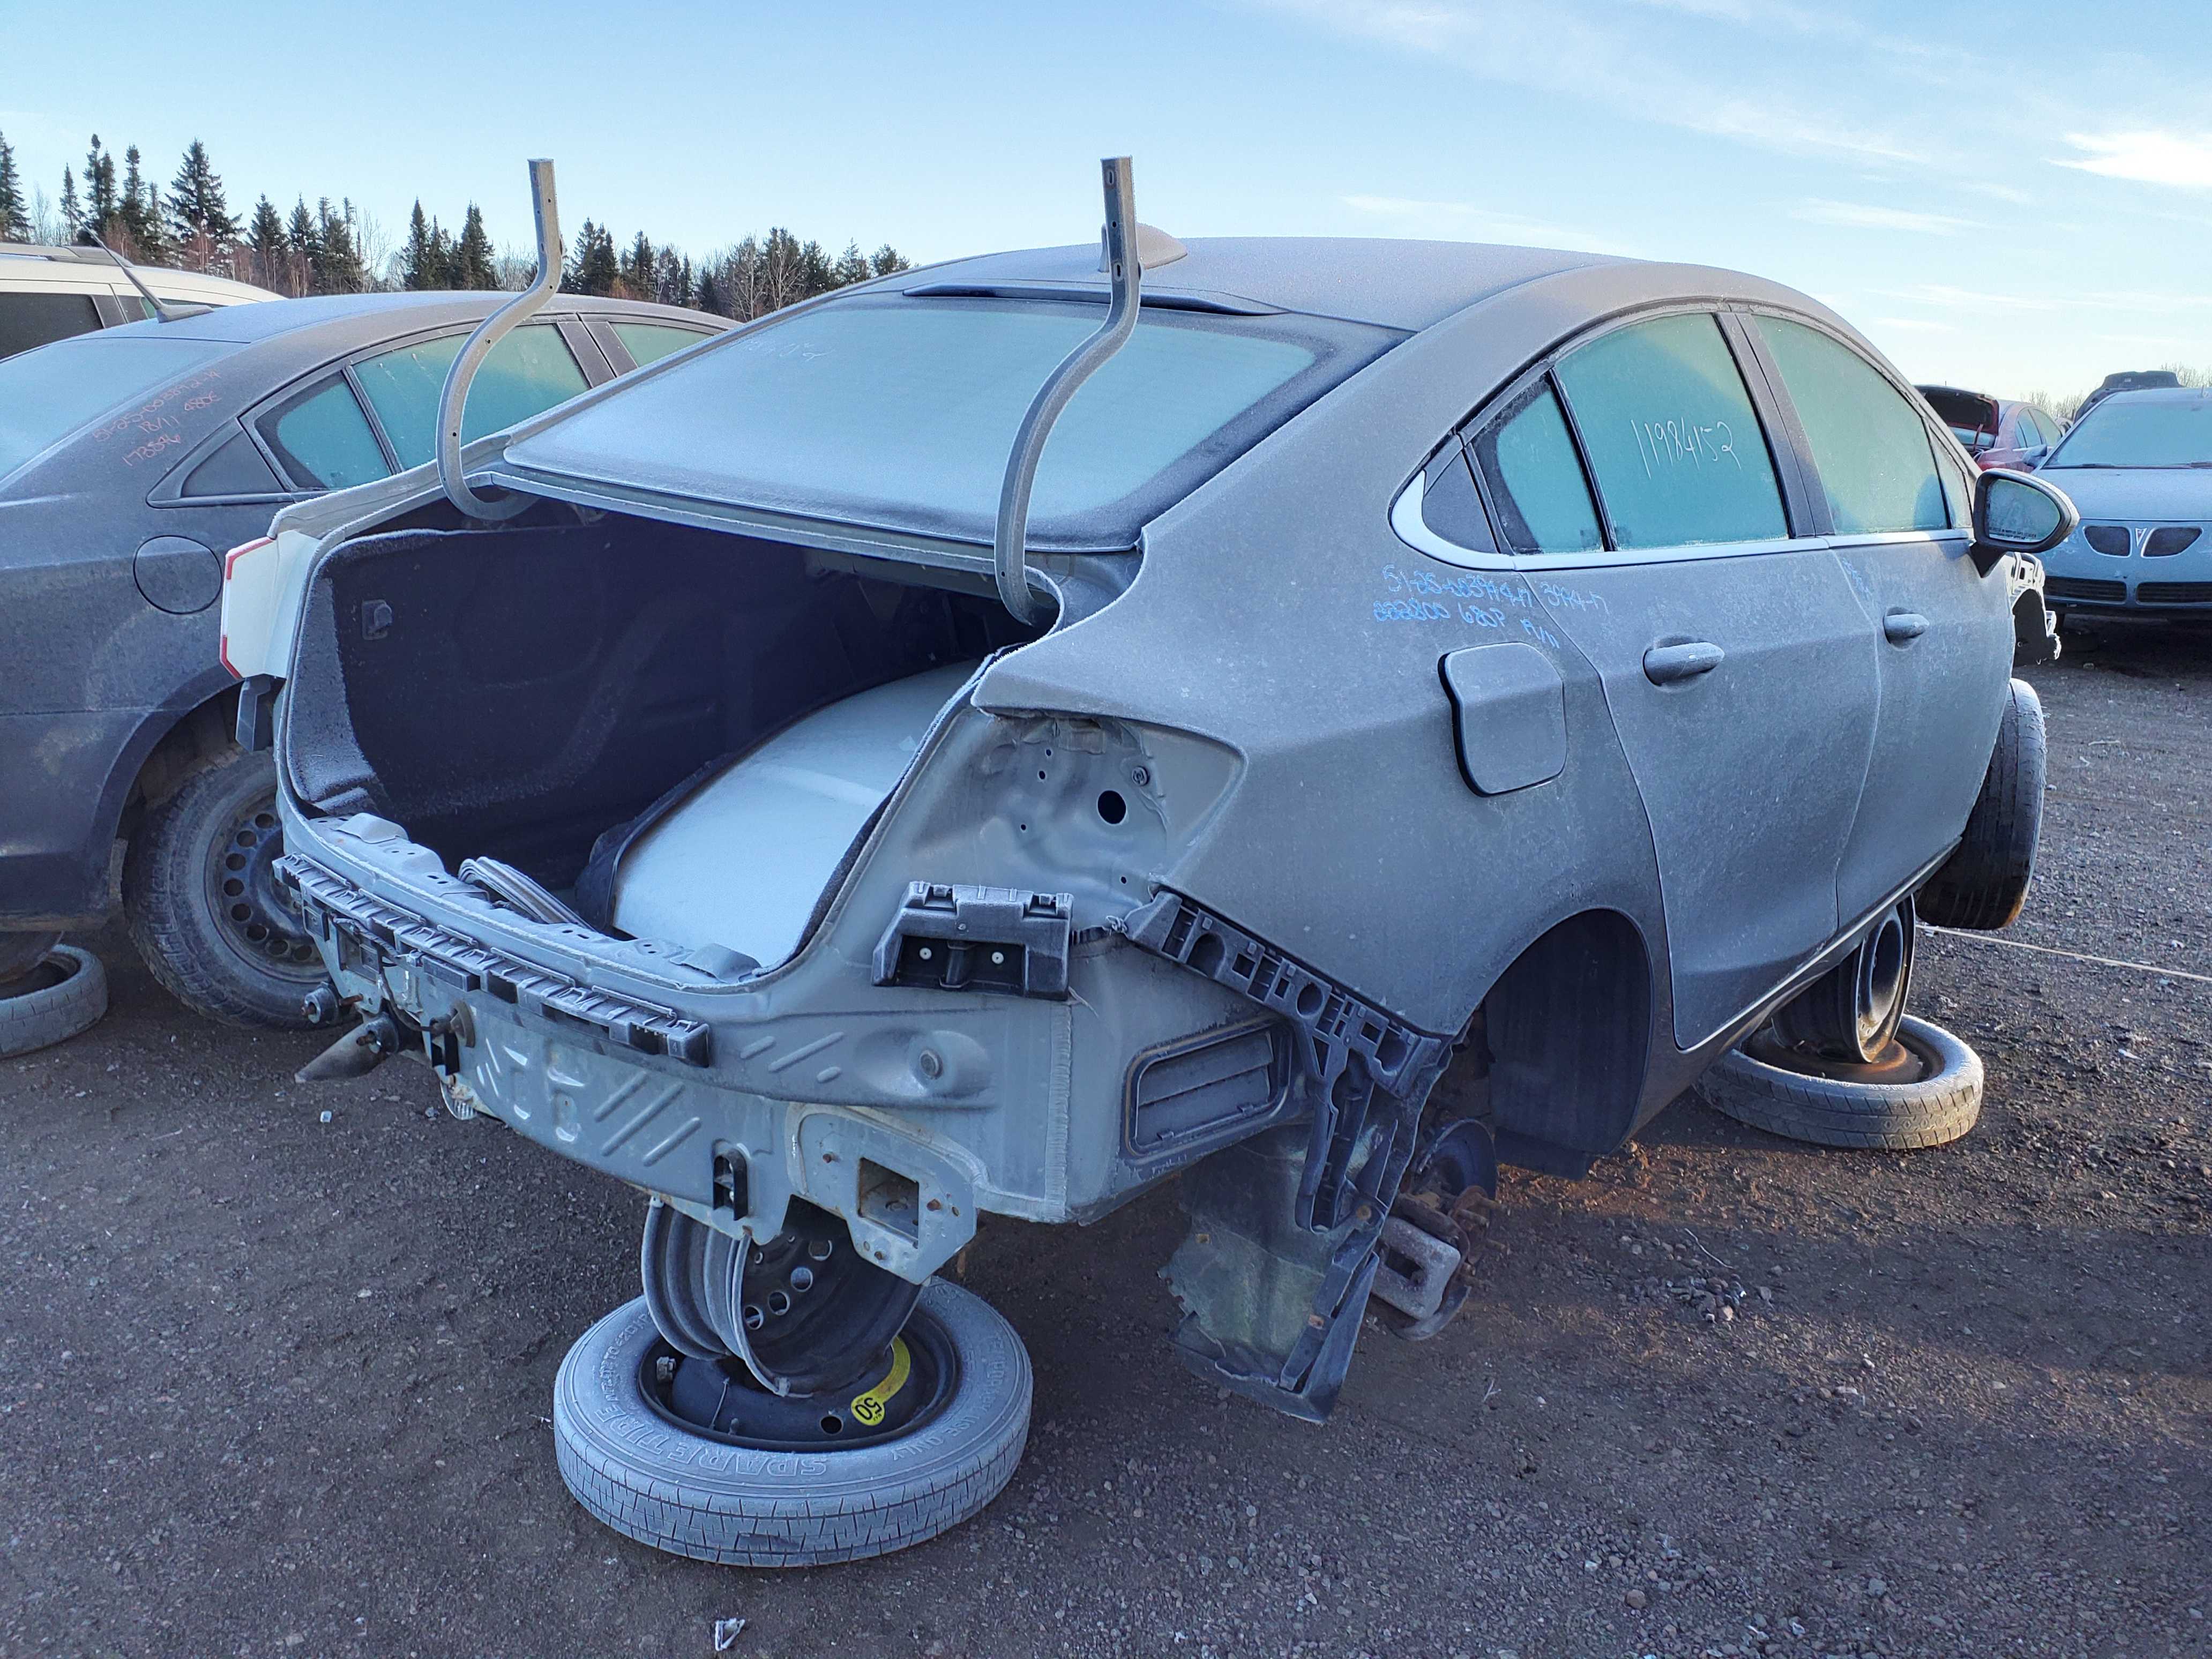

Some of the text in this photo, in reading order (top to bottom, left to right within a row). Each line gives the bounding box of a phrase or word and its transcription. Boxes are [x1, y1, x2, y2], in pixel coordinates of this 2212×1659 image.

[1631, 416, 1742, 480] 11984152
[594, 1404, 829, 1477] SPARE TIRE
[855, 1397, 882, 1421] 50
